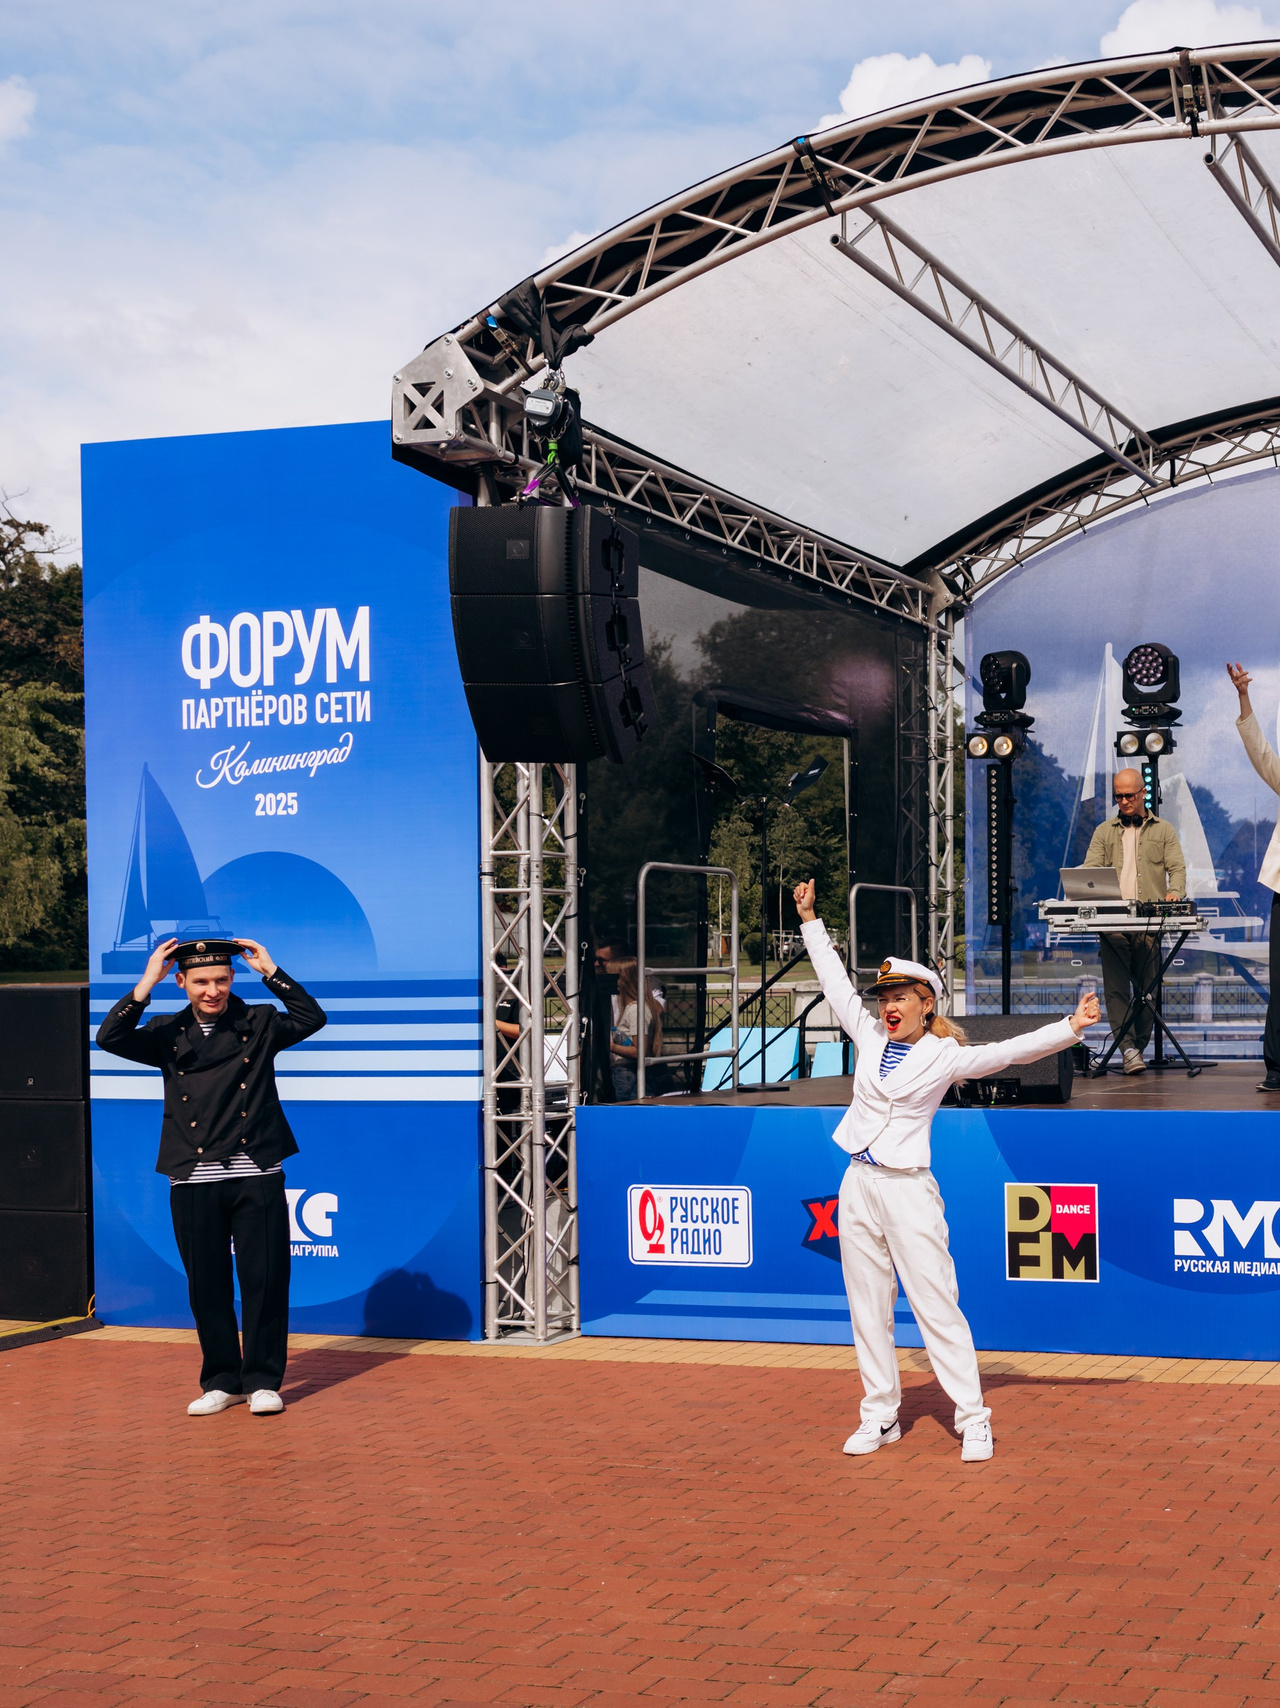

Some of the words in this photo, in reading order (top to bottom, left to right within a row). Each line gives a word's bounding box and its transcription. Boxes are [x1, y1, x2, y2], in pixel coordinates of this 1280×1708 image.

[182, 606, 370, 689] ФОРУМ
[182, 690, 308, 730] ПАРТНЁРОВ
[315, 690, 371, 724] СЕТИ
[195, 732, 354, 789] Калининград
[254, 792, 299, 817] 2025
[669, 1196, 740, 1225] РУССКОЕ
[1056, 1204, 1091, 1215] DANCE
[290, 1244, 339, 1258] АГРУППА
[670, 1228, 722, 1256] РАДИО
[1174, 1259, 1230, 1274] РУССКАЯ
